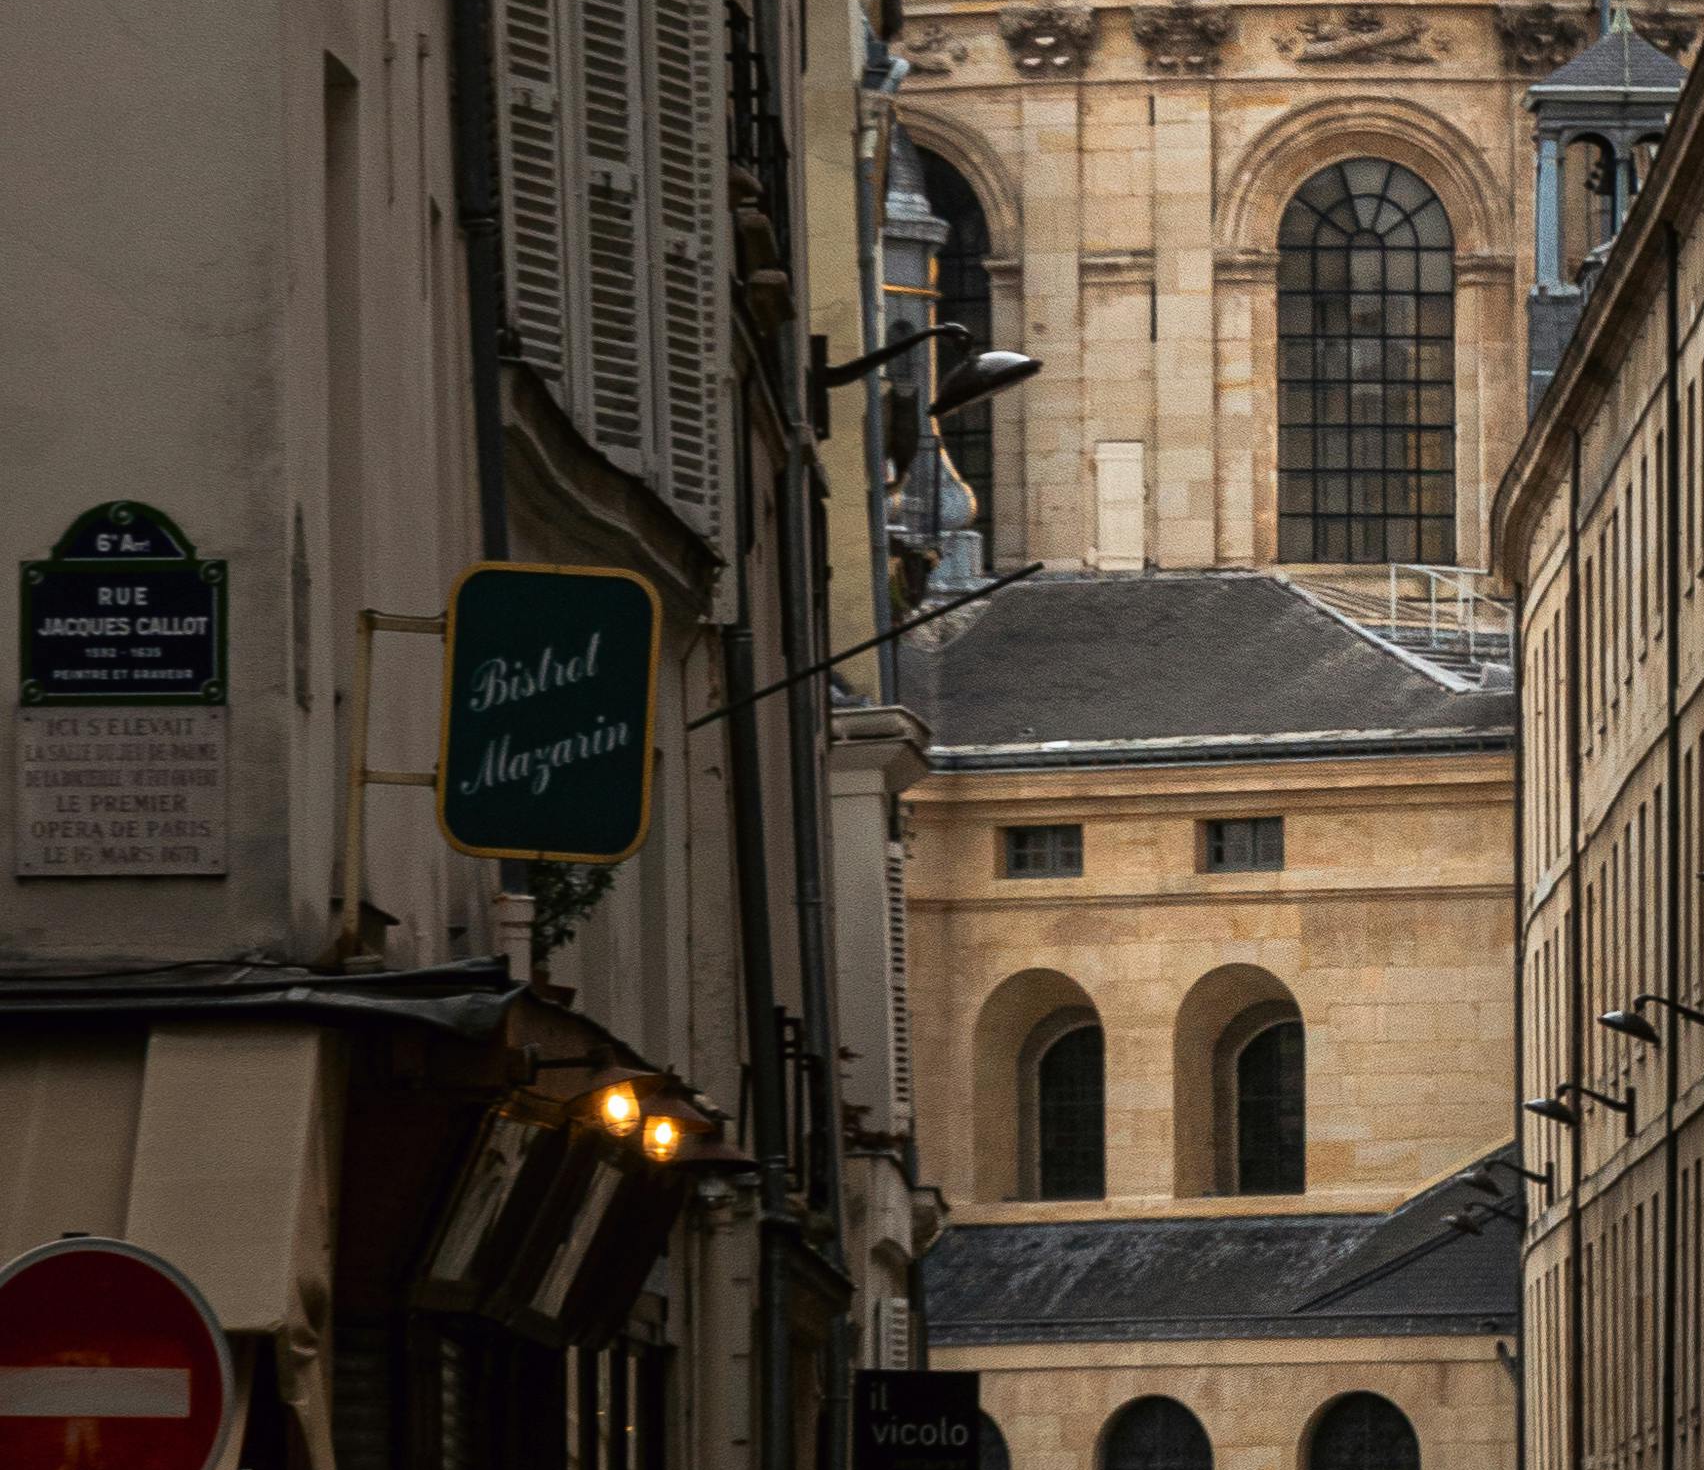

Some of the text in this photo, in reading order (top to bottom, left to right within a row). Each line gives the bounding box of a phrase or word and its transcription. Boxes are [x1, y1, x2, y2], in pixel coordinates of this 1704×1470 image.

[96, 586, 149, 606] RUE
[38, 616, 208, 637] JACQUES CALLOT
[112, 669, 128, 680] ET
[459, 715, 629, 796] Mazarin
[56, 794, 188, 812] LE PREMIER
[110, 820, 139, 838] DE
[146, 820, 212, 838] PARIS
[869, 1381, 888, 1411] il
[871, 1415, 970, 1446] vicolo
